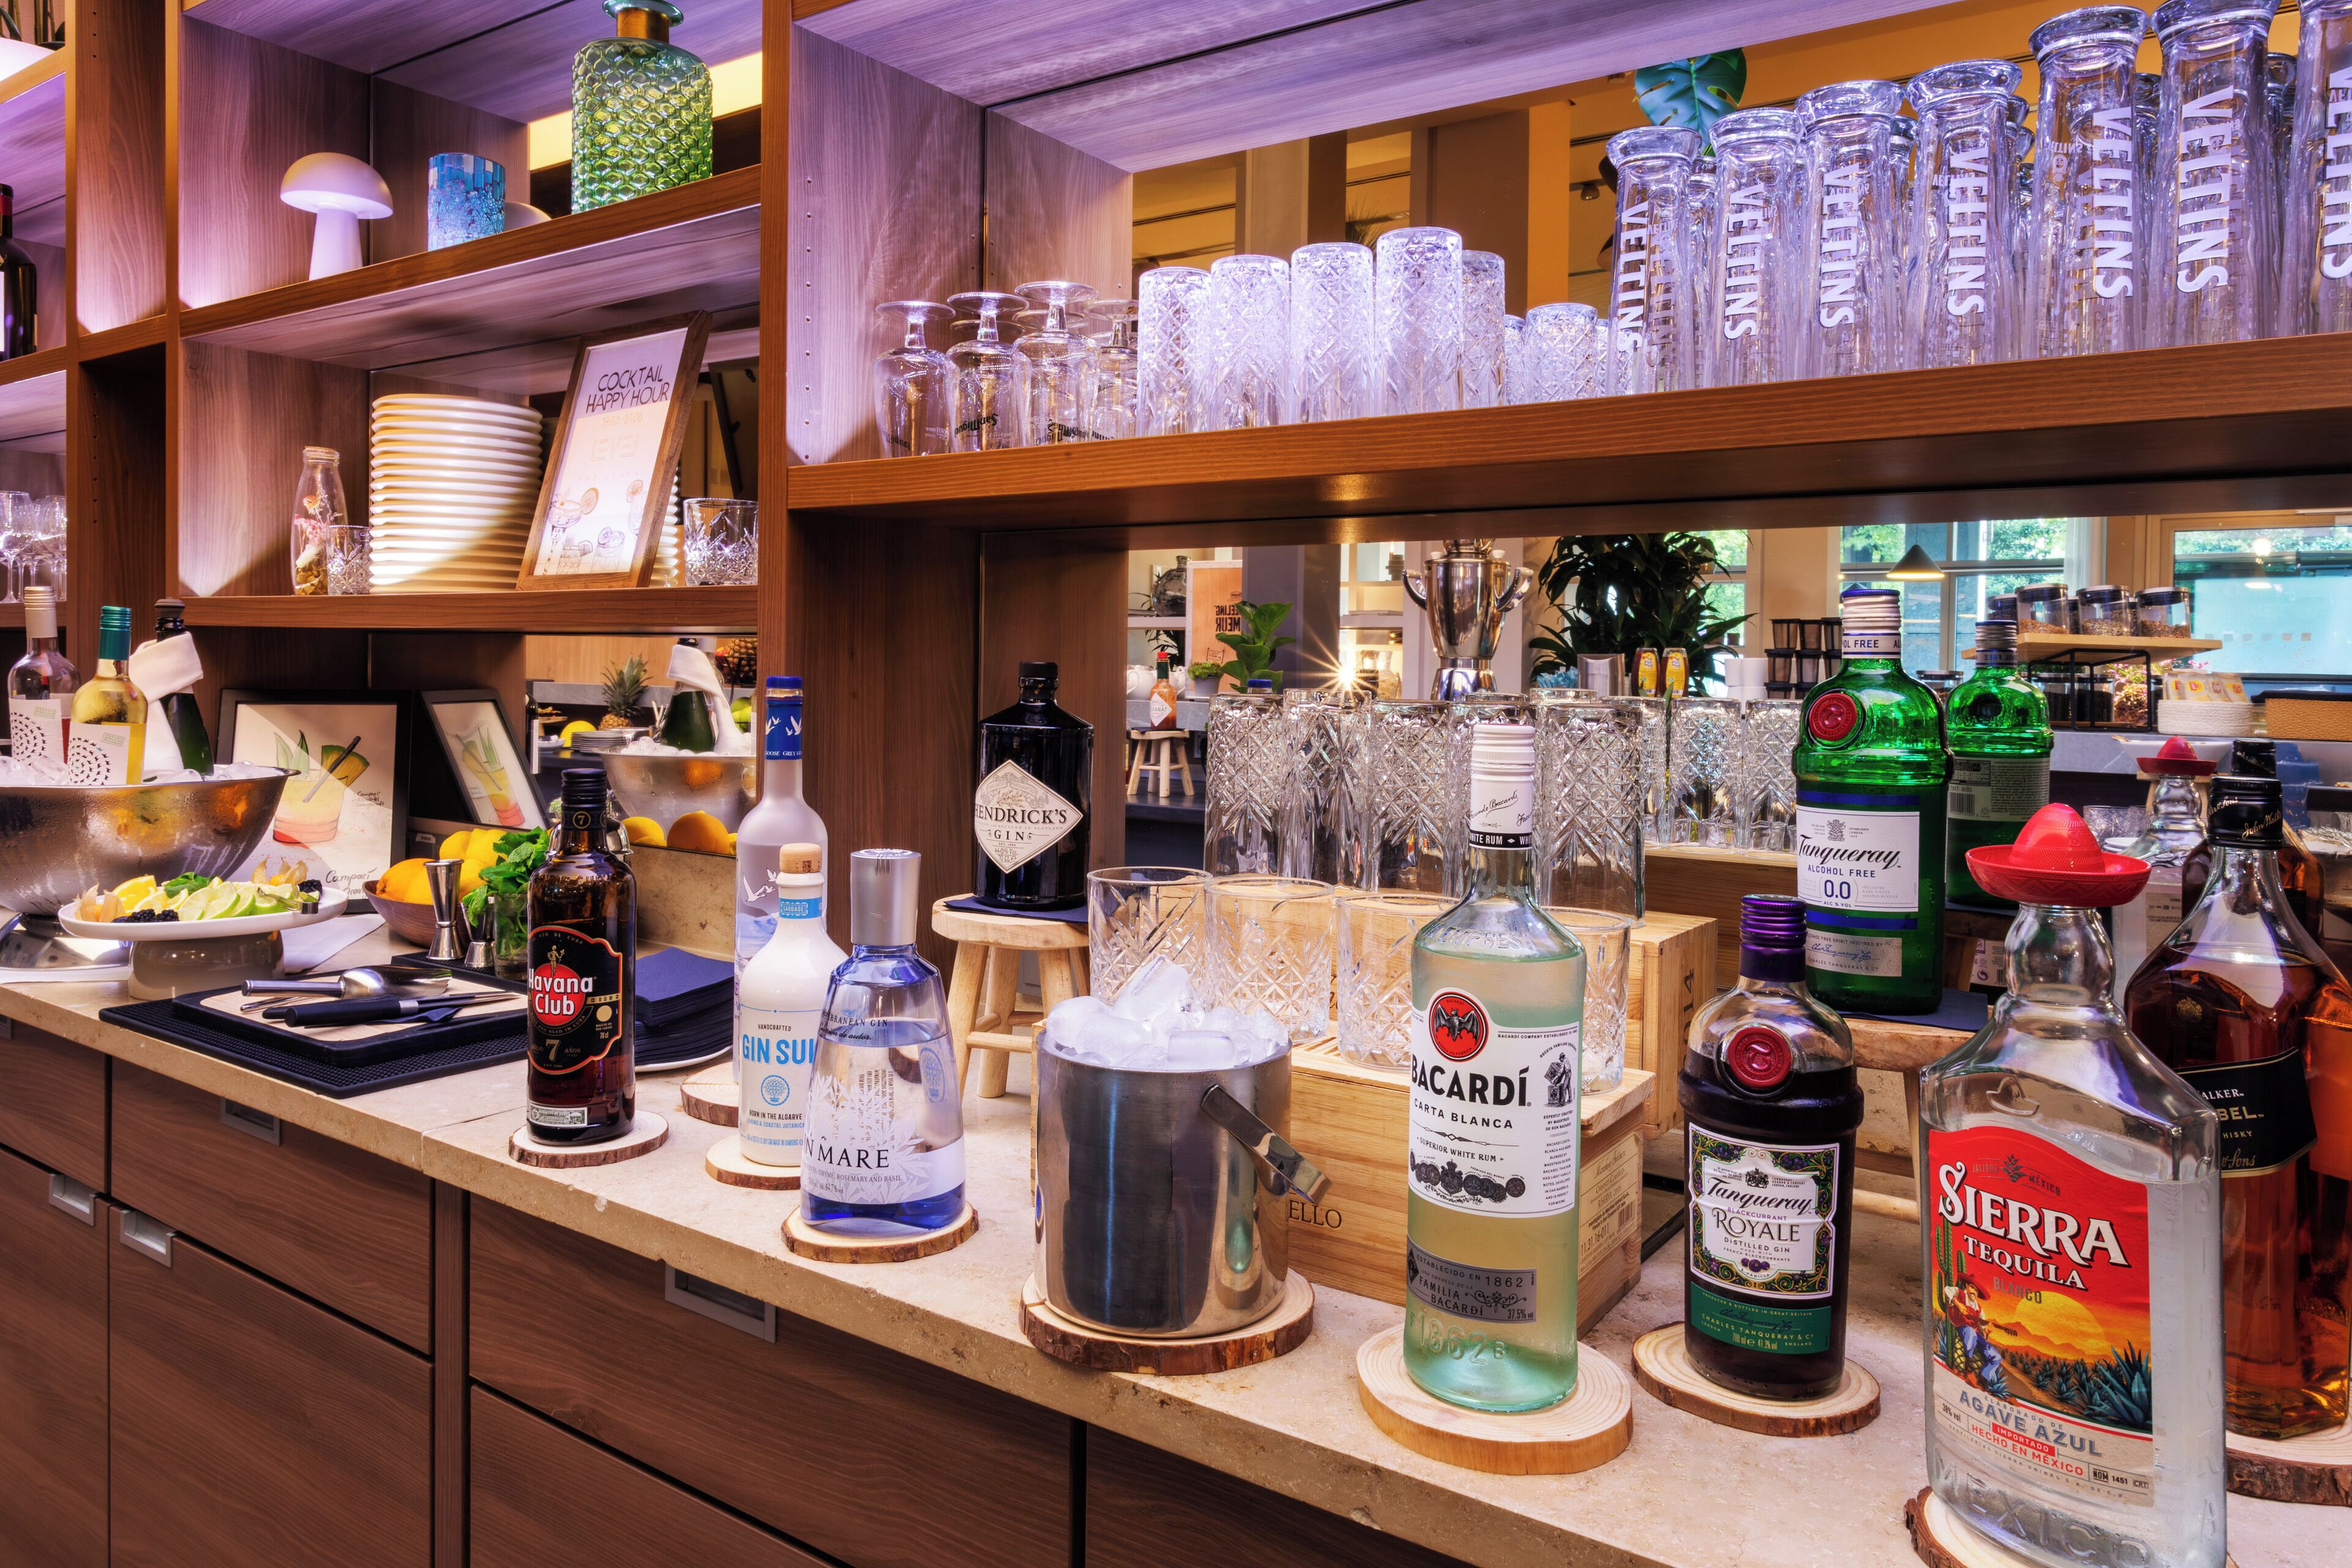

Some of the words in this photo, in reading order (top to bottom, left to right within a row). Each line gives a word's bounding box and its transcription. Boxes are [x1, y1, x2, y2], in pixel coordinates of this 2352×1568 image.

[2177, 85, 2233, 293] VELTINS
[2094, 107, 2133, 298] VELTINS
[1947, 147, 1988, 316] VELTINS
[1820, 164, 1859, 328] VELTINS
[1724, 184, 1764, 339] VELTINS
[1616, 201, 1648, 353] VELTINS
[598, 365, 663, 392] COCKTAIL
[586, 389, 630, 413] HAPPY
[631, 382, 669, 408] HOUR
[578, 815, 585, 825] 7
[994, 830, 1024, 841] GIN
[1471, 834, 1483, 843] HITE
[1485, 834, 1502, 845] RUM
[1798, 834, 1901, 870] Tanqueray
[326, 867, 377, 886] Campari
[1808, 864, 1844, 876] ALCOHOL
[1849, 869, 1875, 878] FREE
[1824, 879, 1851, 900] 0.0
[1828, 962, 1863, 971] TANQUERAY
[529, 968, 593, 993] Havana
[535, 993, 575, 1016] Club
[545, 1039, 561, 1063] 7
[742, 1034, 769, 1064] GIN
[1539, 1047, 1553, 1058] RECETA
[1412, 1054, 1529, 1107] BACARDÍ
[1414, 1098, 1444, 1118] CARTA
[1451, 1112, 1513, 1129] BLANCA
[2219, 1106, 2258, 1121] BEL
[818, 1143, 889, 1169] MARE
[1420, 1137, 1448, 1154] SUPERIOR
[1450, 1148, 1476, 1160] WHITE
[837, 1173, 867, 1182] ROSEMARY
[1972, 1163, 1999, 1174] JALISCO
[2029, 1174, 2061, 1196] MÉXICO
[1707, 1177, 1813, 1216] Tanqueray
[1712, 1207, 1800, 1242] ROYALE
[1727, 1207, 1787, 1221] BLACKCURRANT
[1938, 1161, 2132, 1268] SIERRA
[1724, 1237, 1769, 1251] DISTILLED
[1745, 1253, 1790, 1262] BLACKCURRANTS
[1963, 1234, 2089, 1291] TEQUILA
[1417, 1254, 1465, 1278] ESTABLECIDO
[1485, 1276, 1524, 1287] 1862
[1419, 1275, 1460, 1300] FAMILIA
[1993, 1276, 2043, 1304] BLANCO
[1430, 1293, 1484, 1316] BACARDÍ
[1507, 1308, 1527, 1319] 37.5%
[1702, 1292, 1727, 1305] PRODUCED
[1734, 1303, 1759, 1313] BOTTLED
[1701, 1321, 1721, 1332] LONDON
[1702, 1313, 1735, 1331] CHARLES
[1739, 1327, 1794, 1340] TANQUERAY
[1942, 1403, 1952, 1417] 38%
[1985, 1395, 2044, 1423] ELABORADO
[1959, 1390, 2027, 1433] AGAVE
[2035, 1424, 2102, 1457] AZUL
[1972, 1424, 2008, 1449] HECHO
[2012, 1443, 2027, 1457] EN
[2032, 1452, 2083, 1476] MÉXICO
[1997, 1427, 2049, 1452] IMPORTADO
[1994, 1450, 2023, 1466] SIERRA
[2027, 1466, 2060, 1480] UNIDAS
[2092, 1469, 2109, 1482] NOM
[2112, 1475, 2128, 1485] 1451
[2132, 1479, 2149, 1489] CRT
